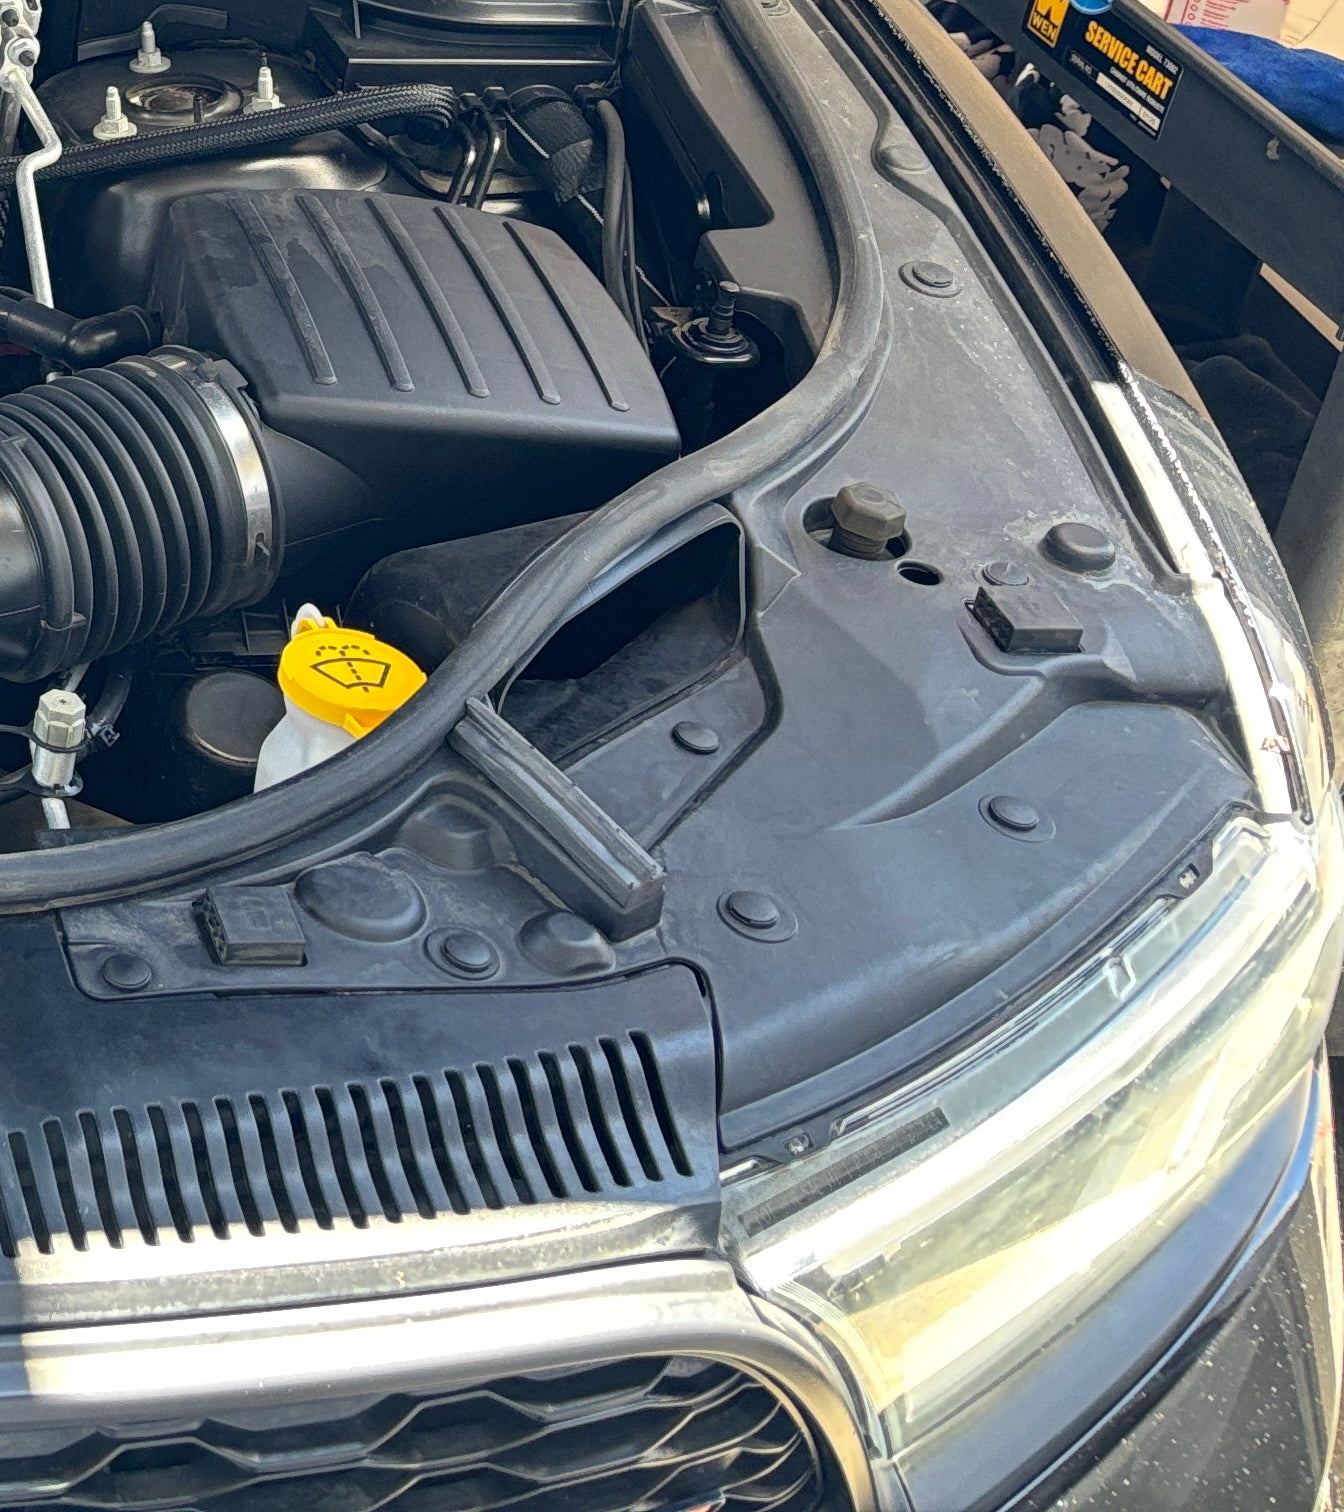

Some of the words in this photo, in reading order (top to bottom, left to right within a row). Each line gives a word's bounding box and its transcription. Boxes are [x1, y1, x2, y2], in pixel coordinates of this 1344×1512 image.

[1032, 11, 1058, 39] WEN
[1085, 20, 1140, 75] SERVICE
[1135, 60, 1174, 101] CART
